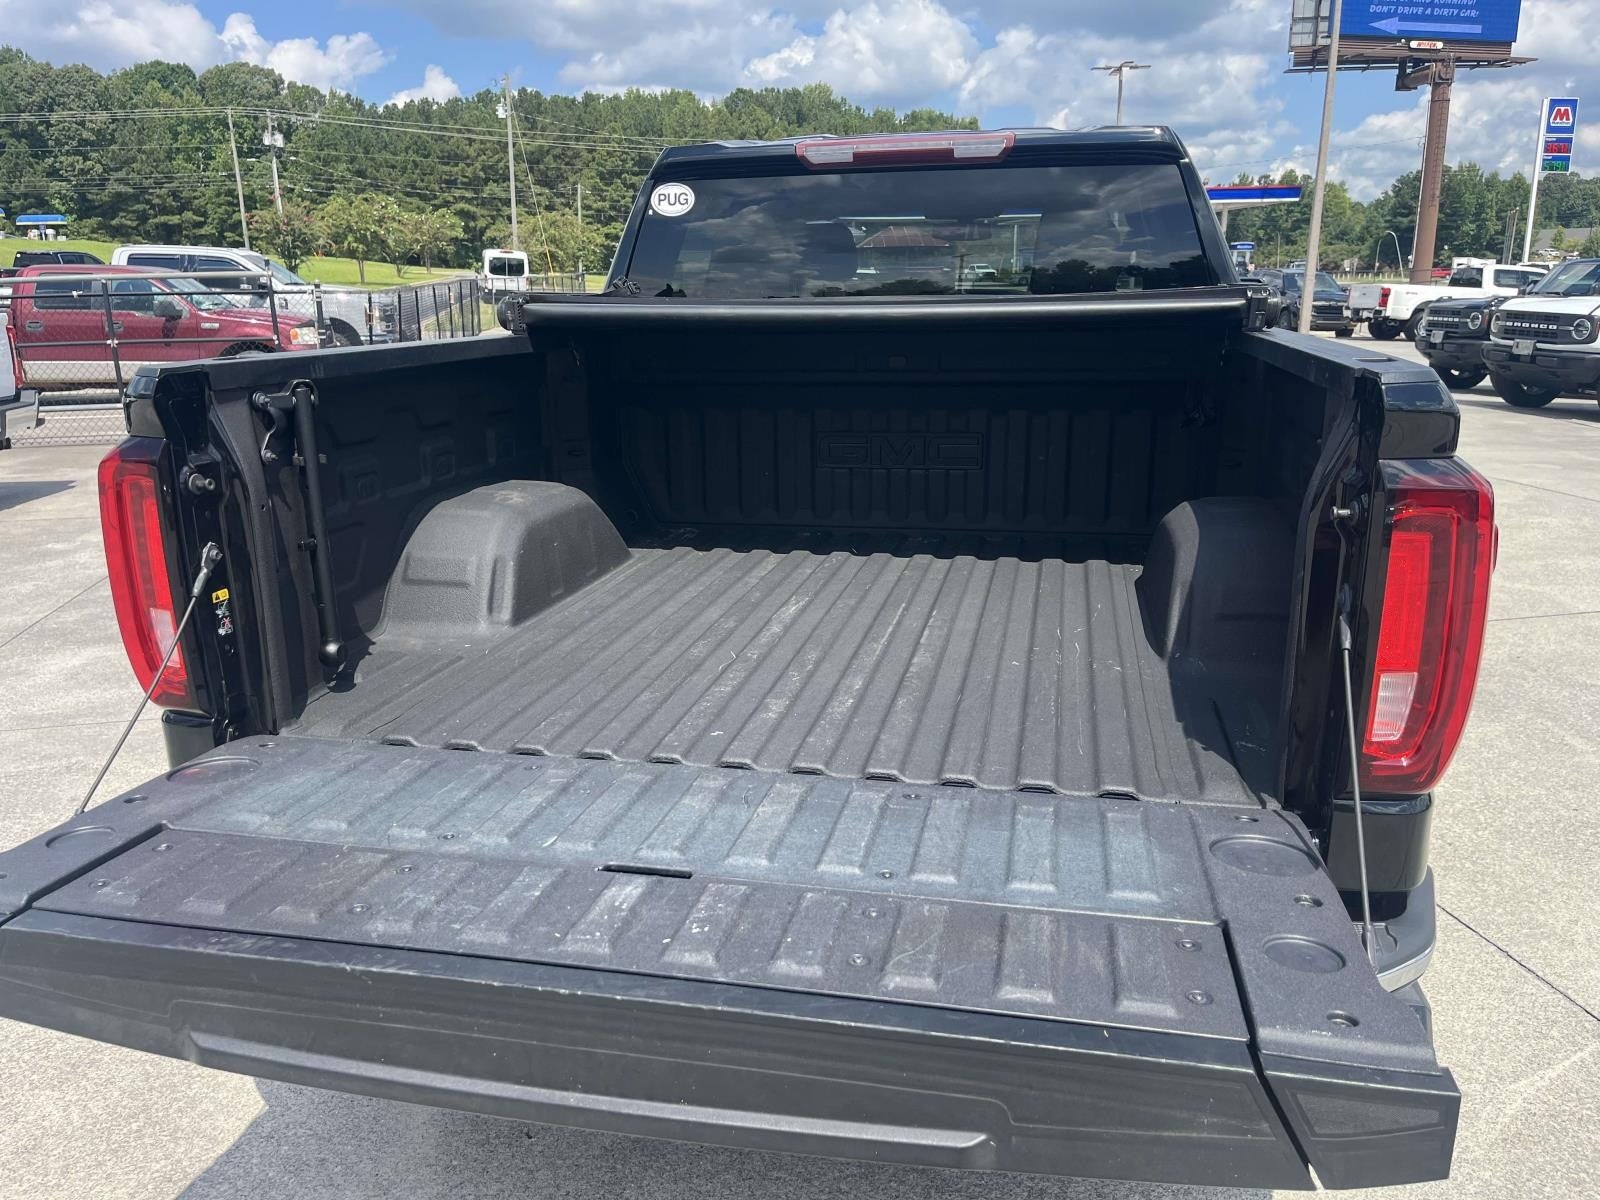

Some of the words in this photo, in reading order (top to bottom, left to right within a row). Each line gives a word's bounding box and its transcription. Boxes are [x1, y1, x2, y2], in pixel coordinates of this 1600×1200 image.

[1369, 4, 1396, 12] DON'T
[1397, 6, 1424, 14] DRIVE
[1434, 8, 1459, 16] DIRTY
[1460, 9, 1479, 17] CAR!
[658, 192, 689, 206] PUG
[819, 432, 981, 469] GMC
